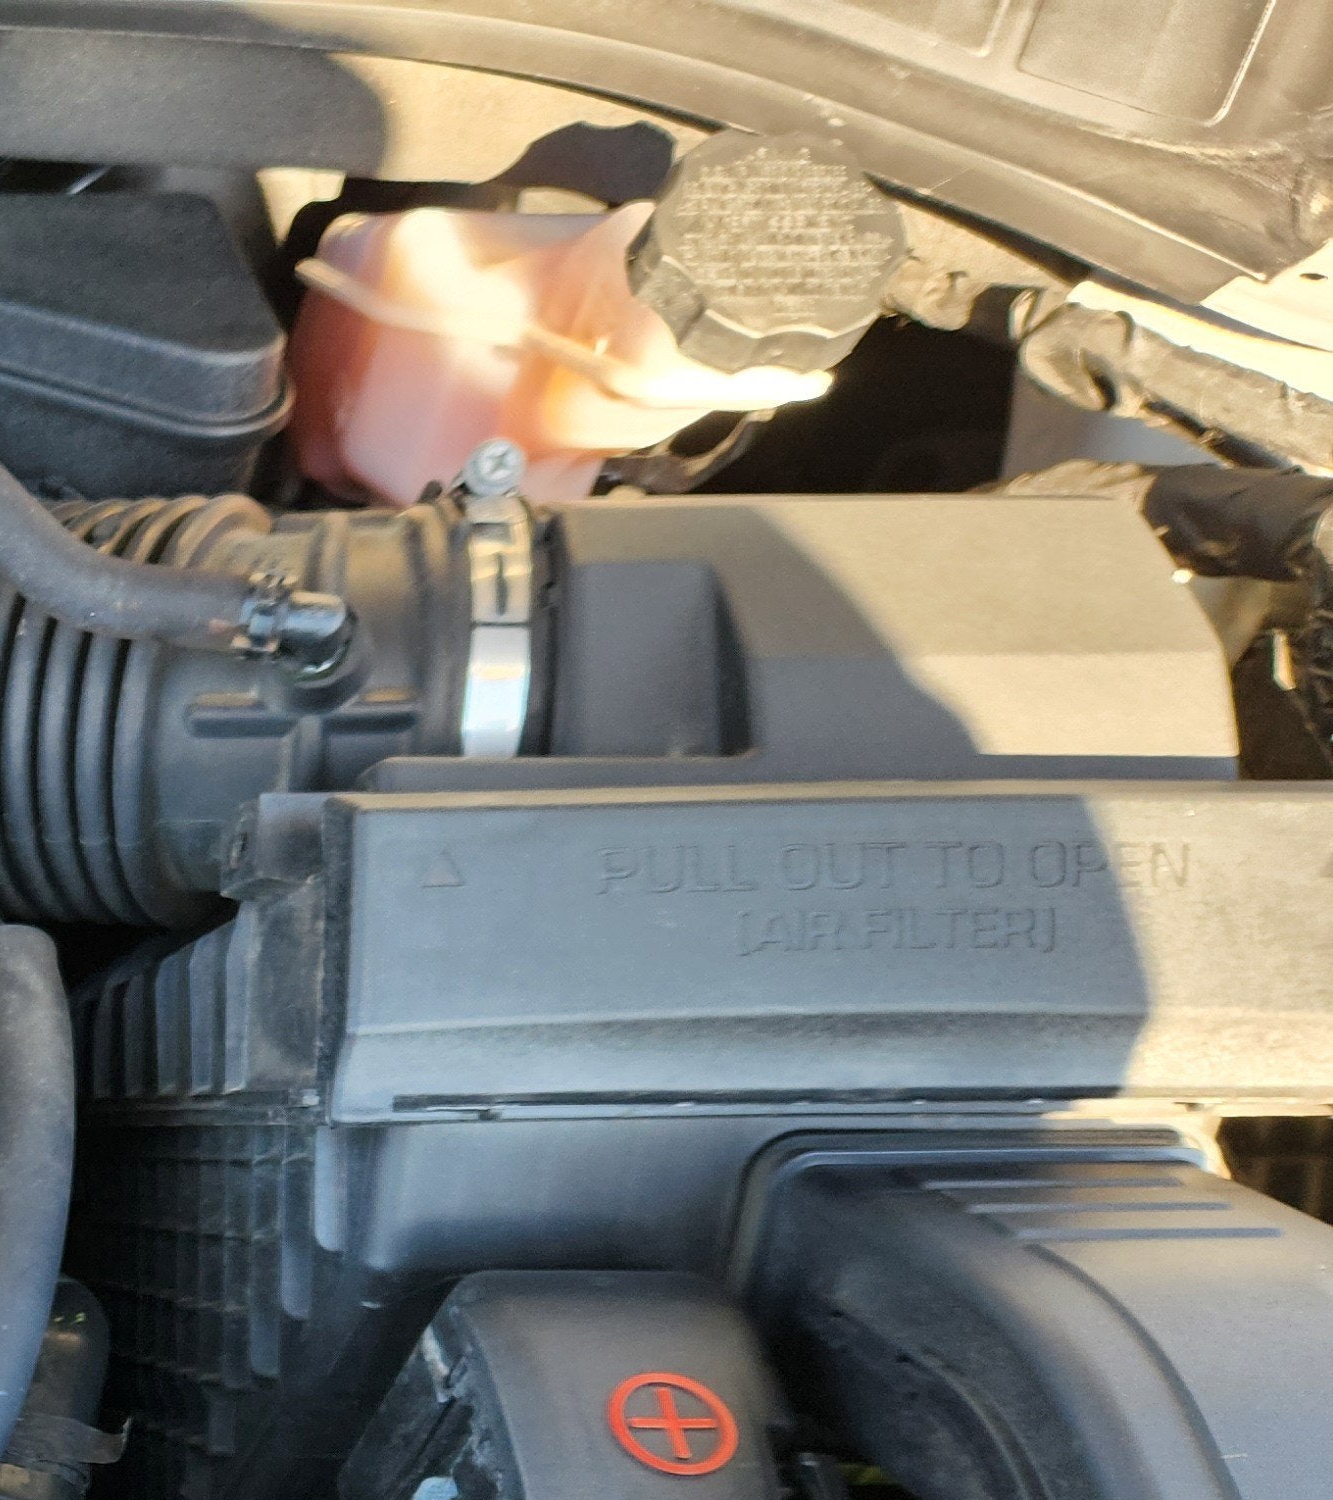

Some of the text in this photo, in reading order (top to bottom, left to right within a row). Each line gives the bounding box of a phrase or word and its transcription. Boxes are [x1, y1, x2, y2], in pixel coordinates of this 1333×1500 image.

[595, 841, 1190, 895] PULL OUT TO OPEN
